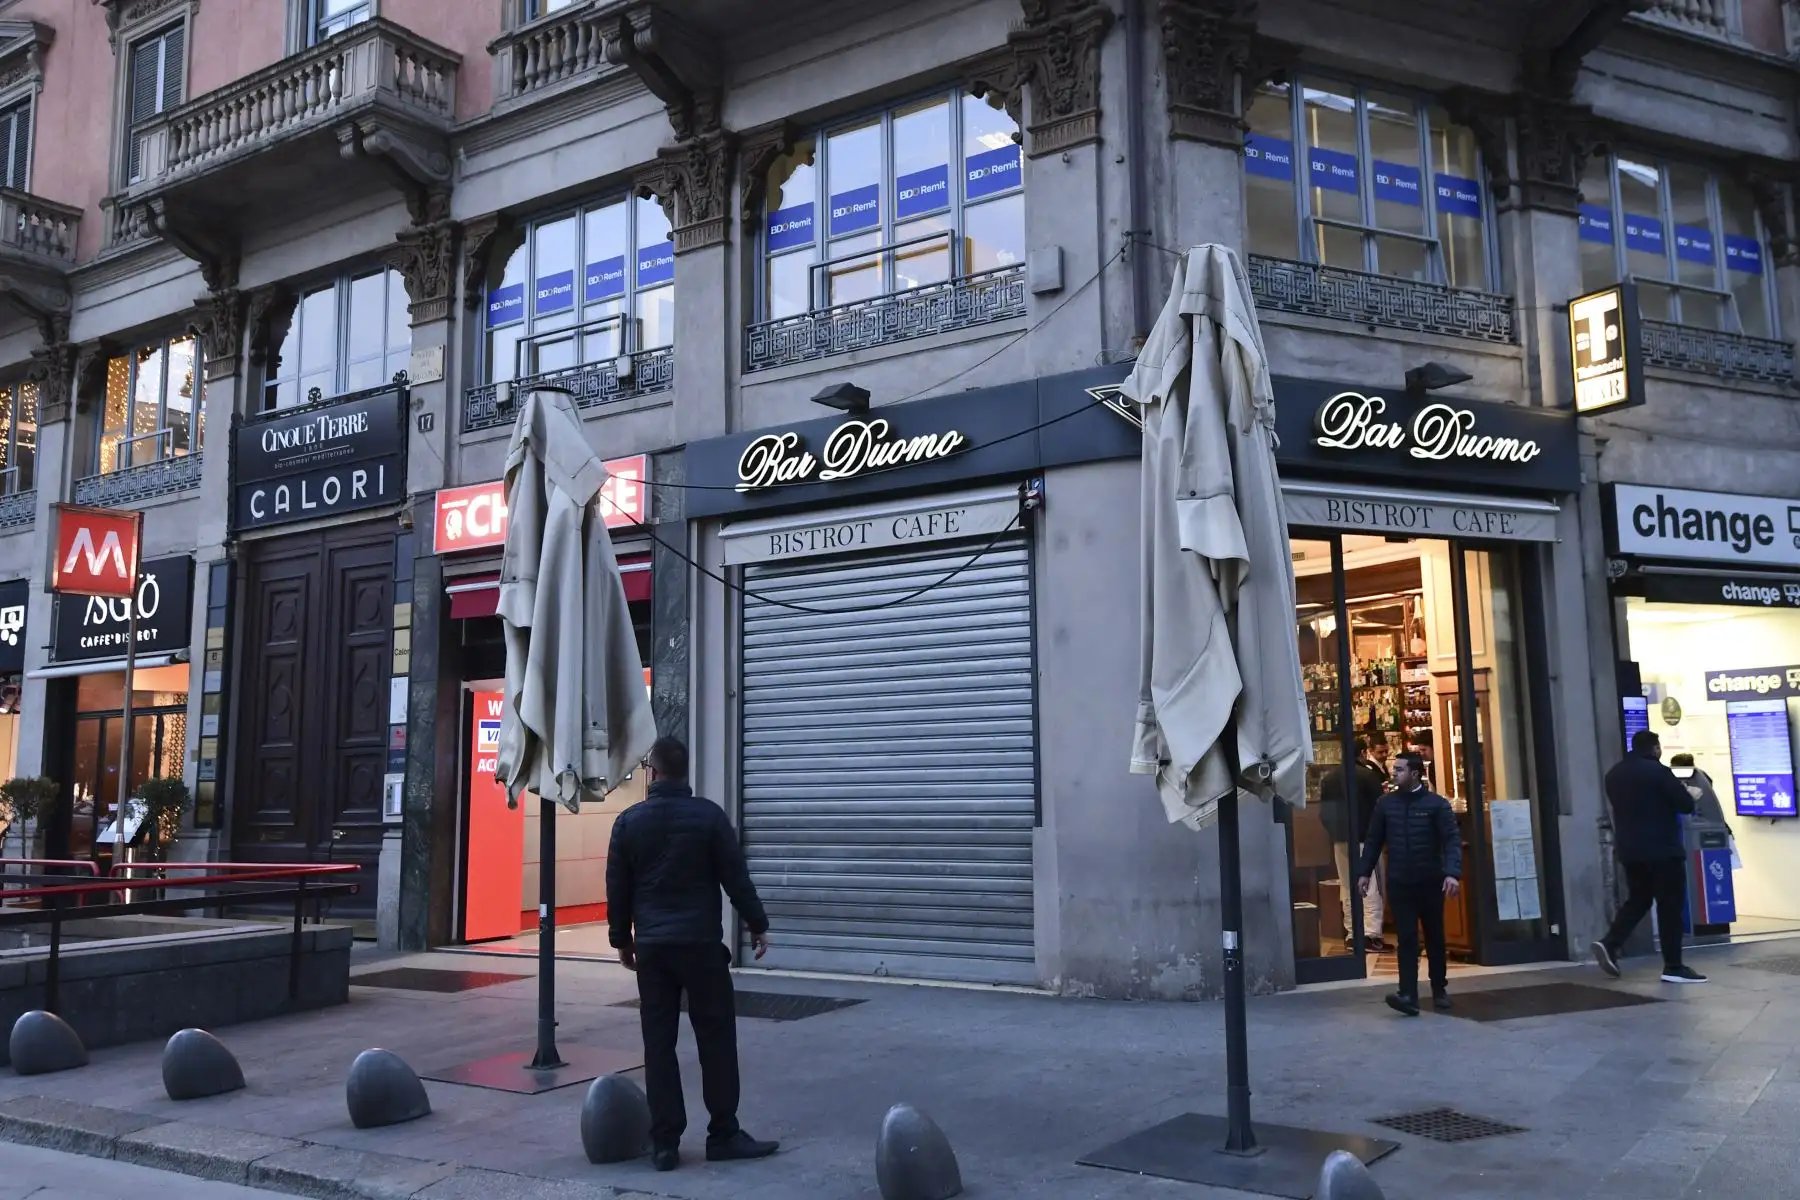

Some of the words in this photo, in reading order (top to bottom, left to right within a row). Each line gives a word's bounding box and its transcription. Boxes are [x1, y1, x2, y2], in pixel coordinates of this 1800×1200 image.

[1265, 151, 1289, 164] Remit
[991, 159, 1018, 174] Remit
[1331, 165, 1355, 178] Remit
[920, 180, 946, 194] Remit
[1395, 178, 1418, 190] Remit
[1456, 191, 1477, 203] Remit
[853, 199, 877, 212] Remit
[789, 217, 812, 229] Remit
[656, 255, 674, 266] Remi
[603, 269, 623, 281] Remit
[553, 283, 571, 294] Remit
[504, 296, 522, 307] Remit
[420, 414, 432, 430] 17
[1317, 391, 1406, 450] Bar
[1409, 403, 1541, 463] Duomo
[262, 423, 316, 453] CINQUE
[316, 411, 369, 441] TERRE
[734, 431, 817, 493] Bar
[818, 418, 964, 481] Duomo
[250, 464, 384, 519] CALORI
[1326, 498, 1434, 529] BISTROT
[1452, 510, 1518, 535] CAFE'
[1632, 494, 1774, 554] change
[768, 522, 873, 556] BISTROT
[891, 510, 967, 541] CAFE'
[62, 527, 129, 578] M
[1722, 581, 1781, 605] change
[115, 629, 158, 645] BISROT
[1708, 673, 1782, 694] change
